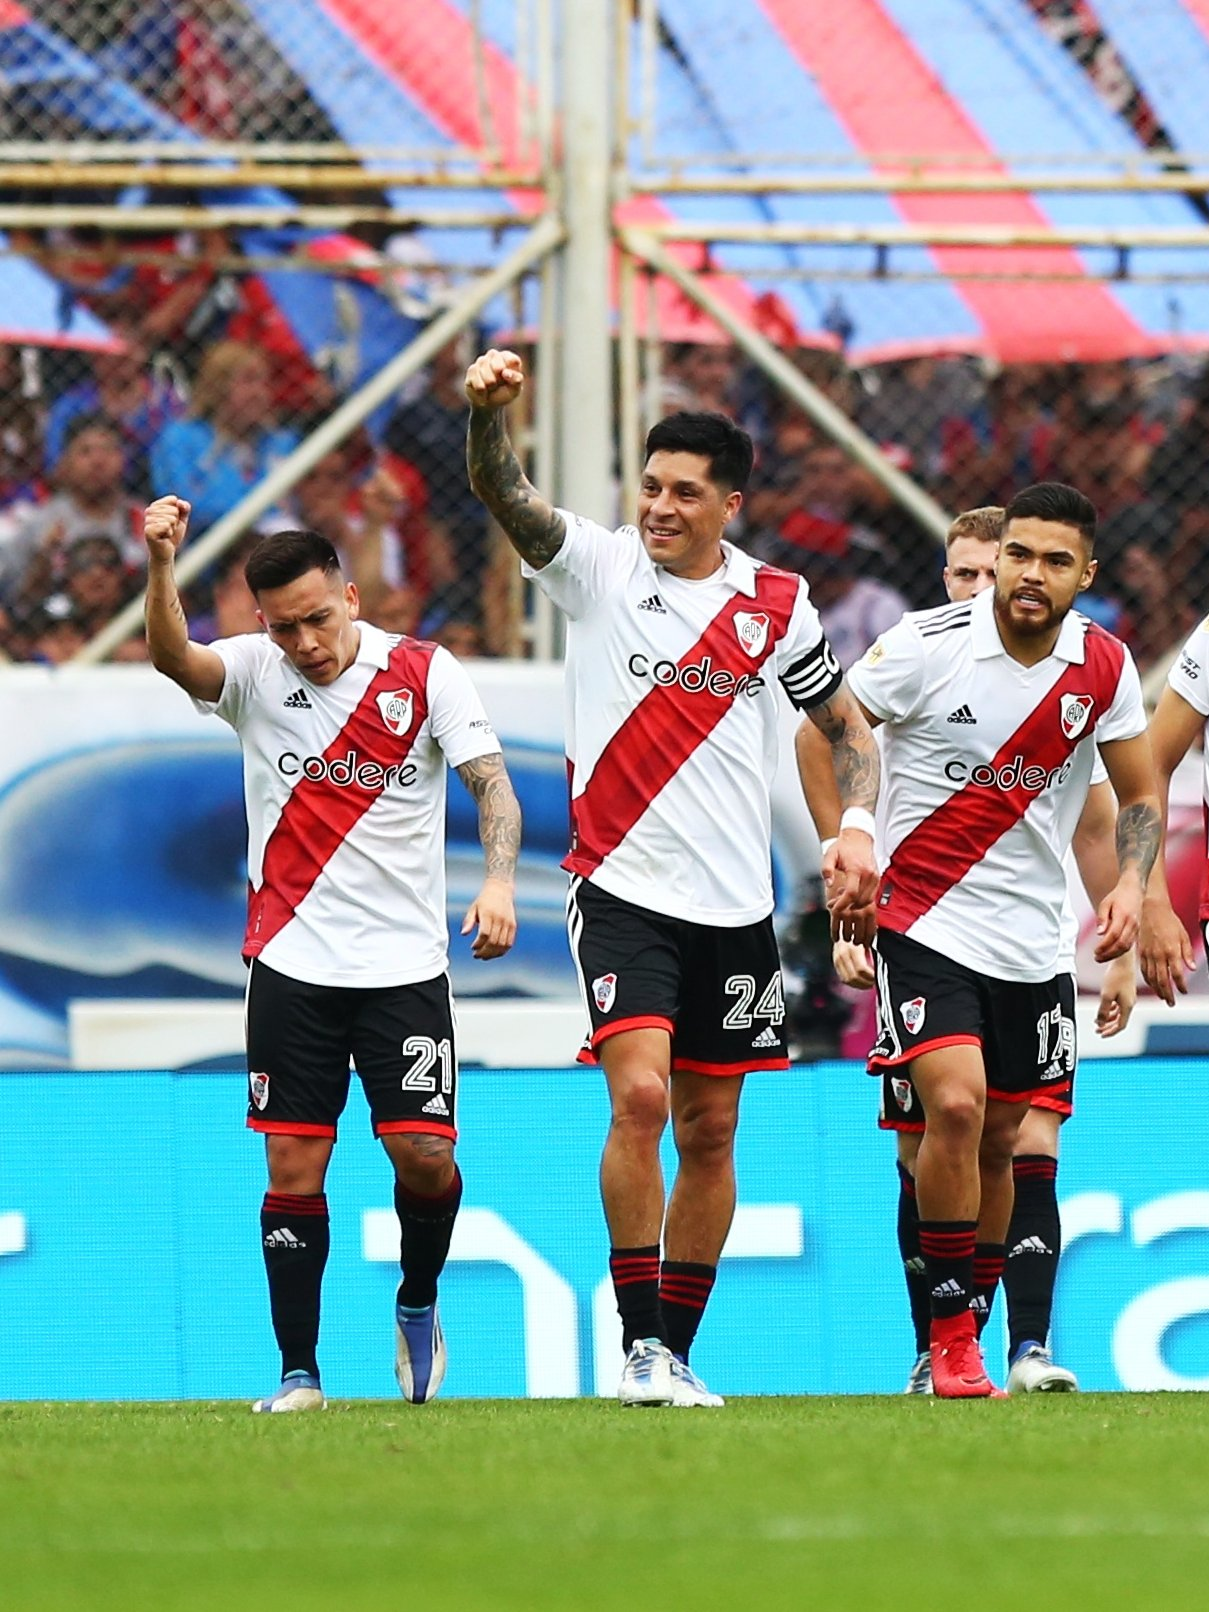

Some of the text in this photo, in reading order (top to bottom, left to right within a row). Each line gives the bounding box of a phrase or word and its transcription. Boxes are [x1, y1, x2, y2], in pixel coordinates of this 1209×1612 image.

[637, 603, 667, 615] adidas
[628, 653, 767, 698] codere
[283, 701, 313, 710] adidas
[946, 715, 977, 725] adidas
[278, 751, 418, 790] codere
[722, 970, 786, 1030] 24
[751, 1039, 781, 1047] adidas
[402, 1035, 452, 1095] 21
[421, 1105, 450, 1116] adidas
